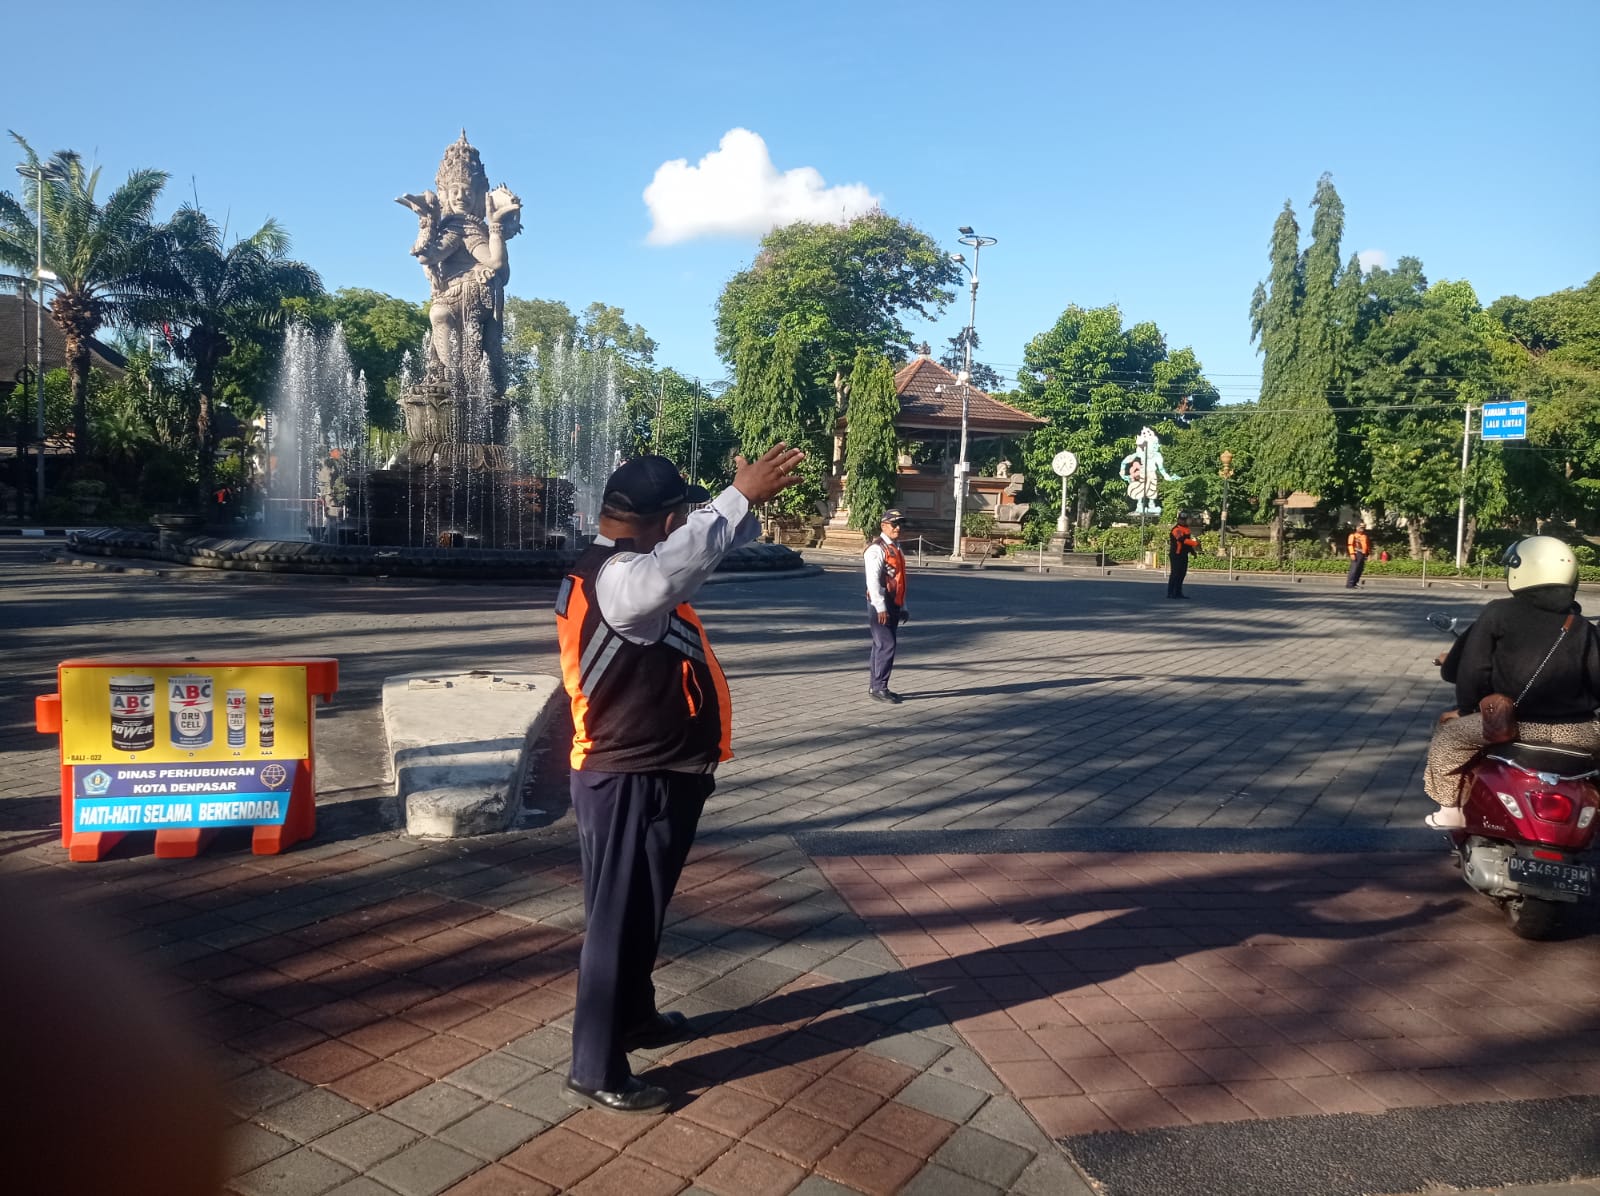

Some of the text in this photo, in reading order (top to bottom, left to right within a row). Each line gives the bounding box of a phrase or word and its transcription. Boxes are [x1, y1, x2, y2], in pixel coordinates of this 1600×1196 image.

[1486, 420, 1499, 428] LALU
[172, 685, 211, 699] ABC
[113, 696, 150, 709] ABC
[226, 697, 246, 705] ABC
[181, 712, 200, 720] DRY
[112, 723, 153, 739] POWER
[180, 721, 201, 729] CELL
[117, 767, 255, 780] DINAS PERHUBUNGAN
[133, 782, 237, 794] KOTA DENPASAR
[79, 801, 280, 826] HATI-HATI SELAMA BERKENDARA
[1510, 858, 1526, 871] DK
